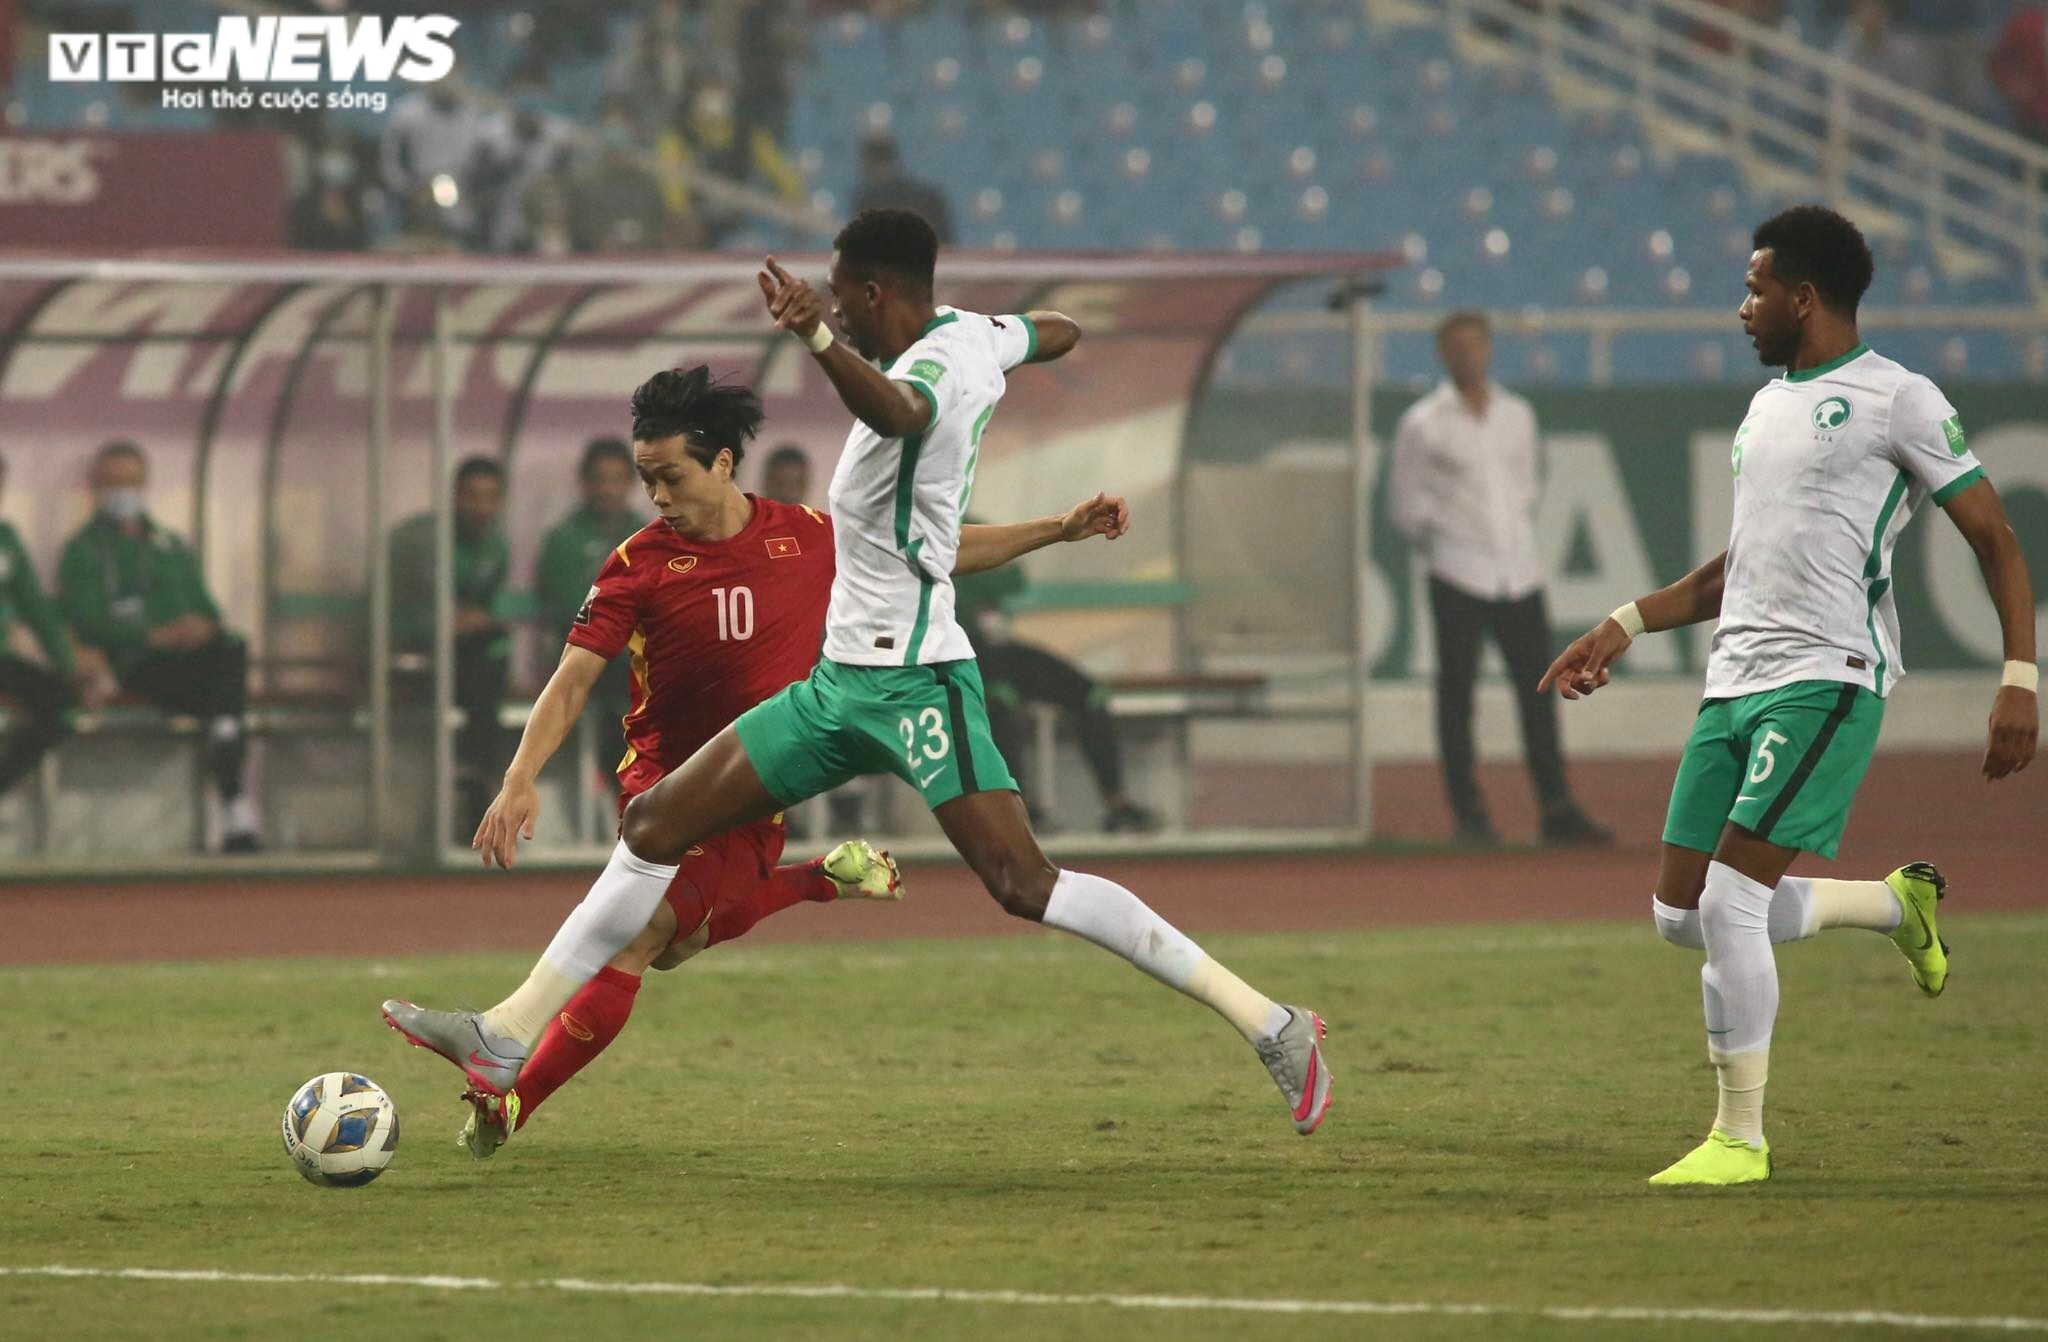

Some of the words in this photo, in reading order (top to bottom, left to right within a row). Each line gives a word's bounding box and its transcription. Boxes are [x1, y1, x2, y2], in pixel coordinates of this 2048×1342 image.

[712, 586, 754, 641] 10
[899, 707, 950, 770] 23
[1751, 730, 1788, 783] 5
